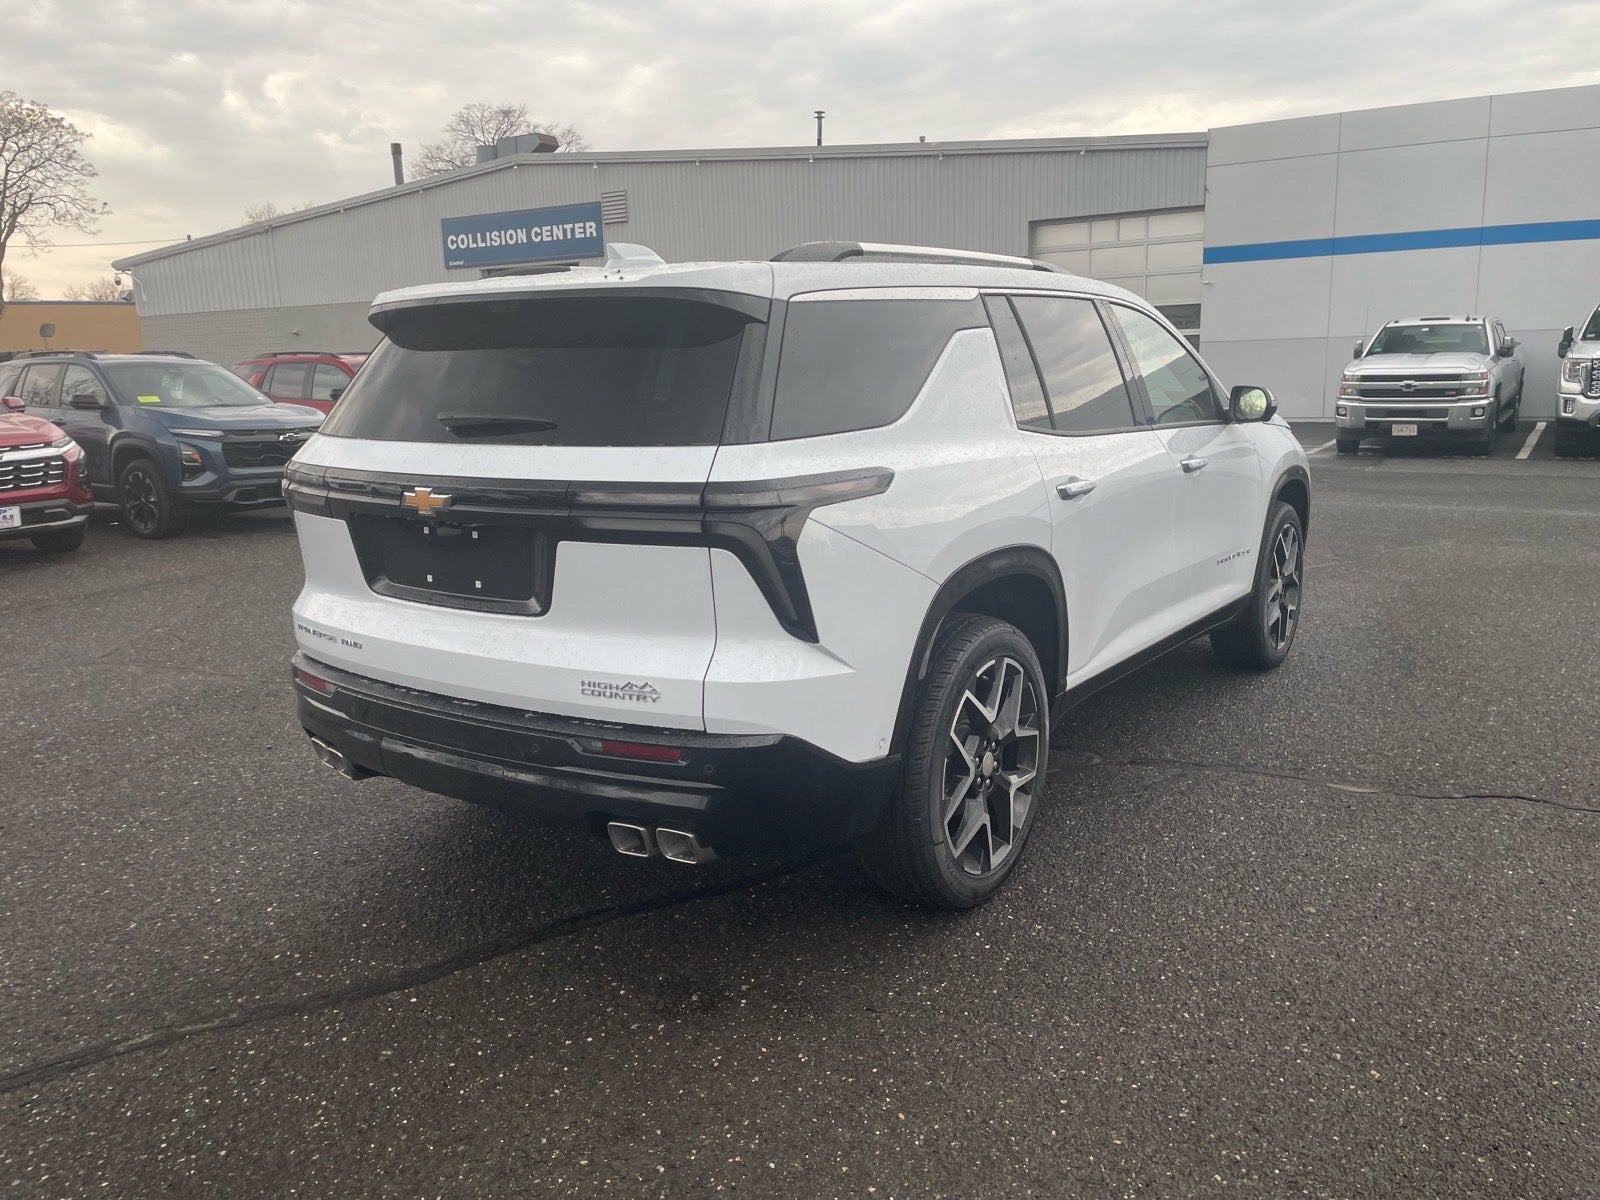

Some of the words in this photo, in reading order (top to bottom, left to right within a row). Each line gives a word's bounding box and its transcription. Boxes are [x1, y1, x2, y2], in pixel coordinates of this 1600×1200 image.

[447, 228, 527, 250] COLLISION
[530, 221, 597, 242] CENTER
[580, 680, 621, 691] HIGH
[580, 688, 661, 703] COUNTRY
